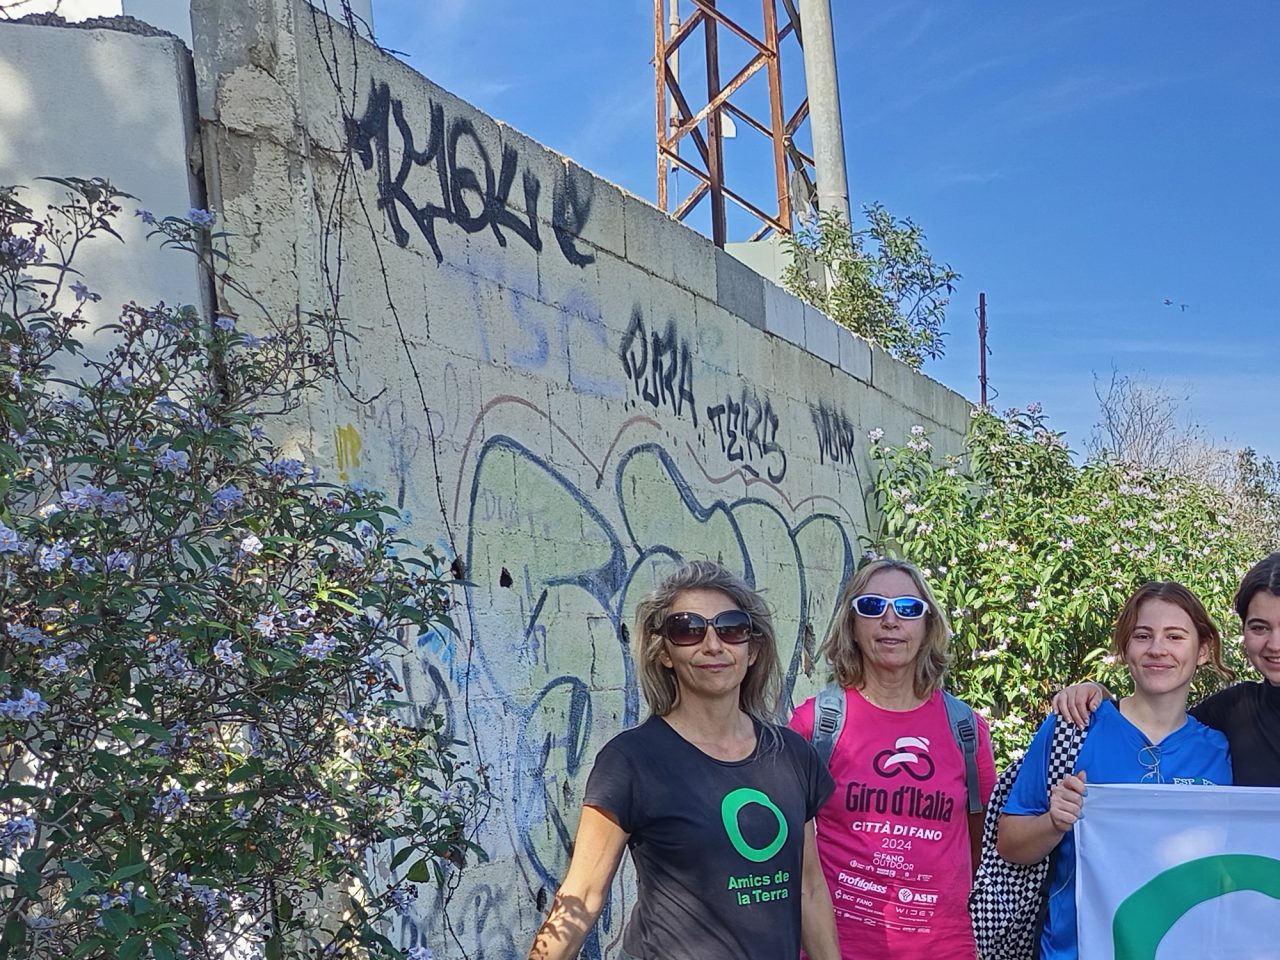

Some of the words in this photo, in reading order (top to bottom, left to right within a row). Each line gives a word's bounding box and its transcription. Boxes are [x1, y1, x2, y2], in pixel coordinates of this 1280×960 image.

[846, 781, 888, 815] Giro
[891, 785, 954, 823] d'Italia
[852, 820, 891, 835] CITTÀ
[893, 824, 908, 836] DI
[909, 826, 943, 841] FANO
[881, 837, 912, 851] 2024
[872, 857, 914, 871] OUTDOOR
[881, 853, 905, 863] FANO
[728, 874, 771, 890] Amics
[774, 870, 790, 883] de
[838, 872, 888, 894] Profilglass
[737, 892, 751, 905] la
[752, 888, 789, 903] Terra
[856, 897, 873, 907] FANO
[913, 893, 938, 903] ASET
